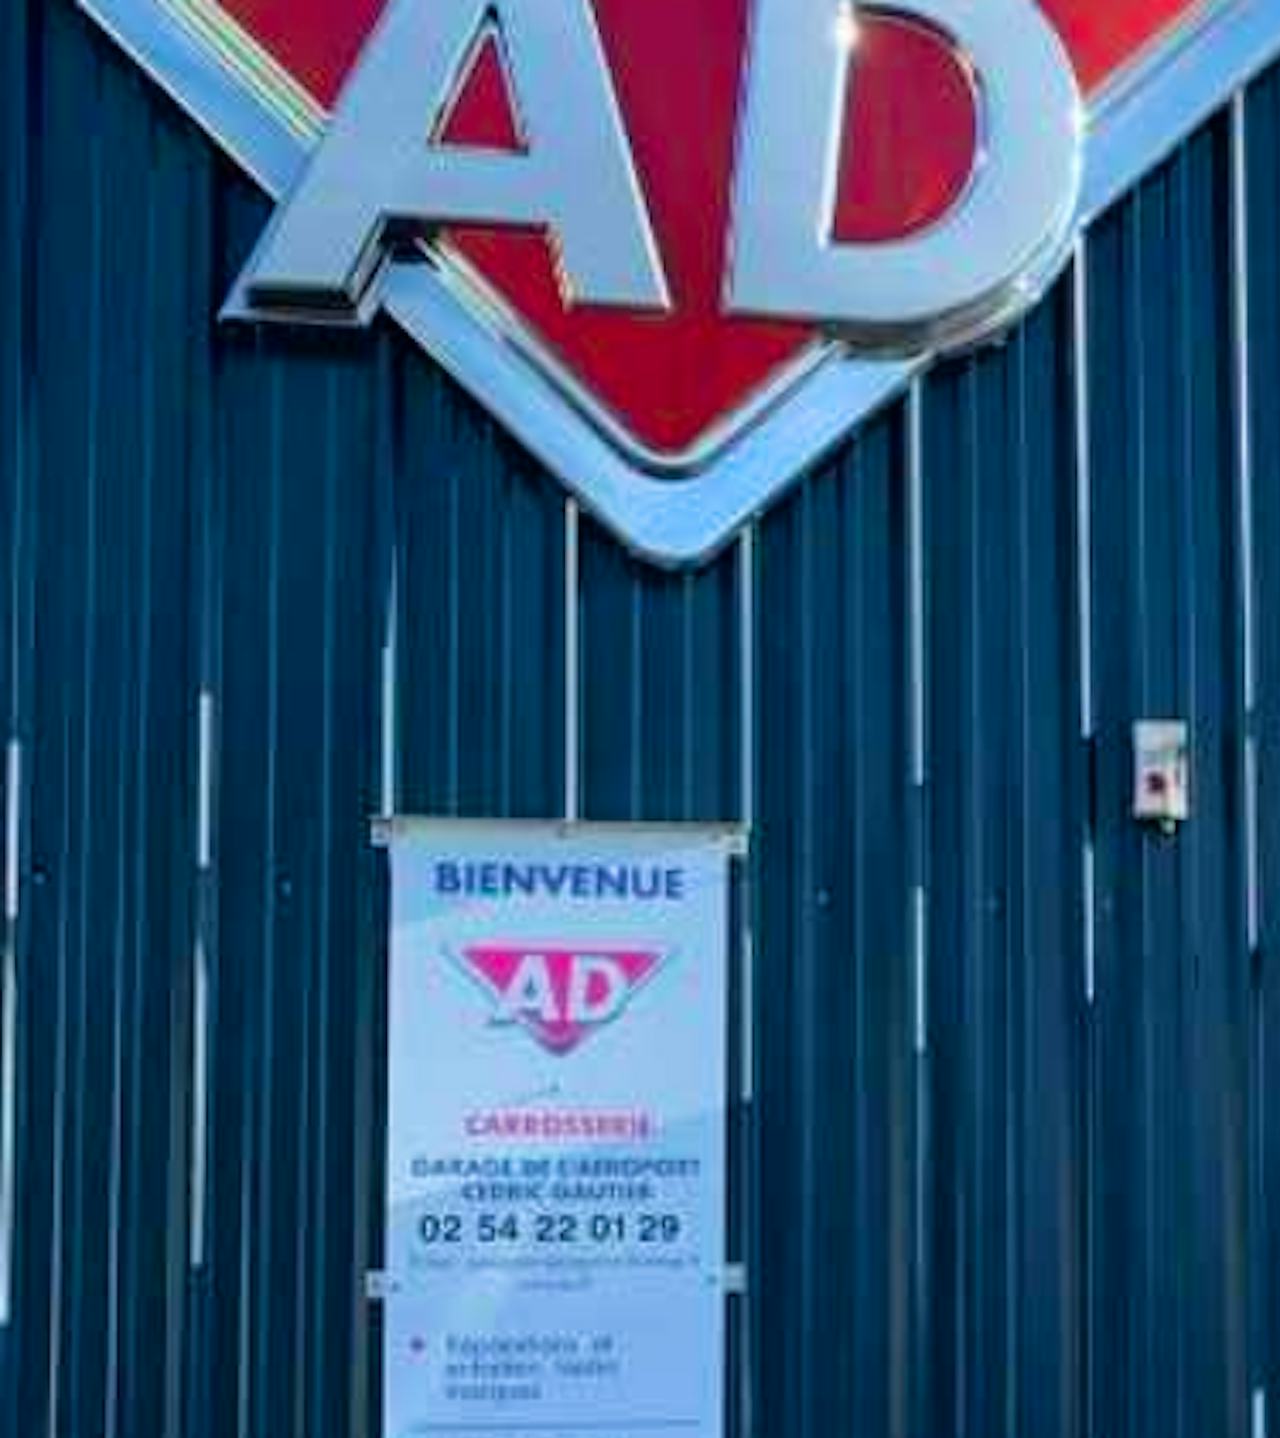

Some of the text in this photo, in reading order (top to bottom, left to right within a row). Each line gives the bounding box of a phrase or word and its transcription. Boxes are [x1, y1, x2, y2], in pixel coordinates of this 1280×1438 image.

[218, 0, 1085, 355] AD
[434, 861, 687, 900] BIENVENUE
[488, 952, 626, 1026] AD
[420, 1212, 681, 1243] 02 54 22 01 29
